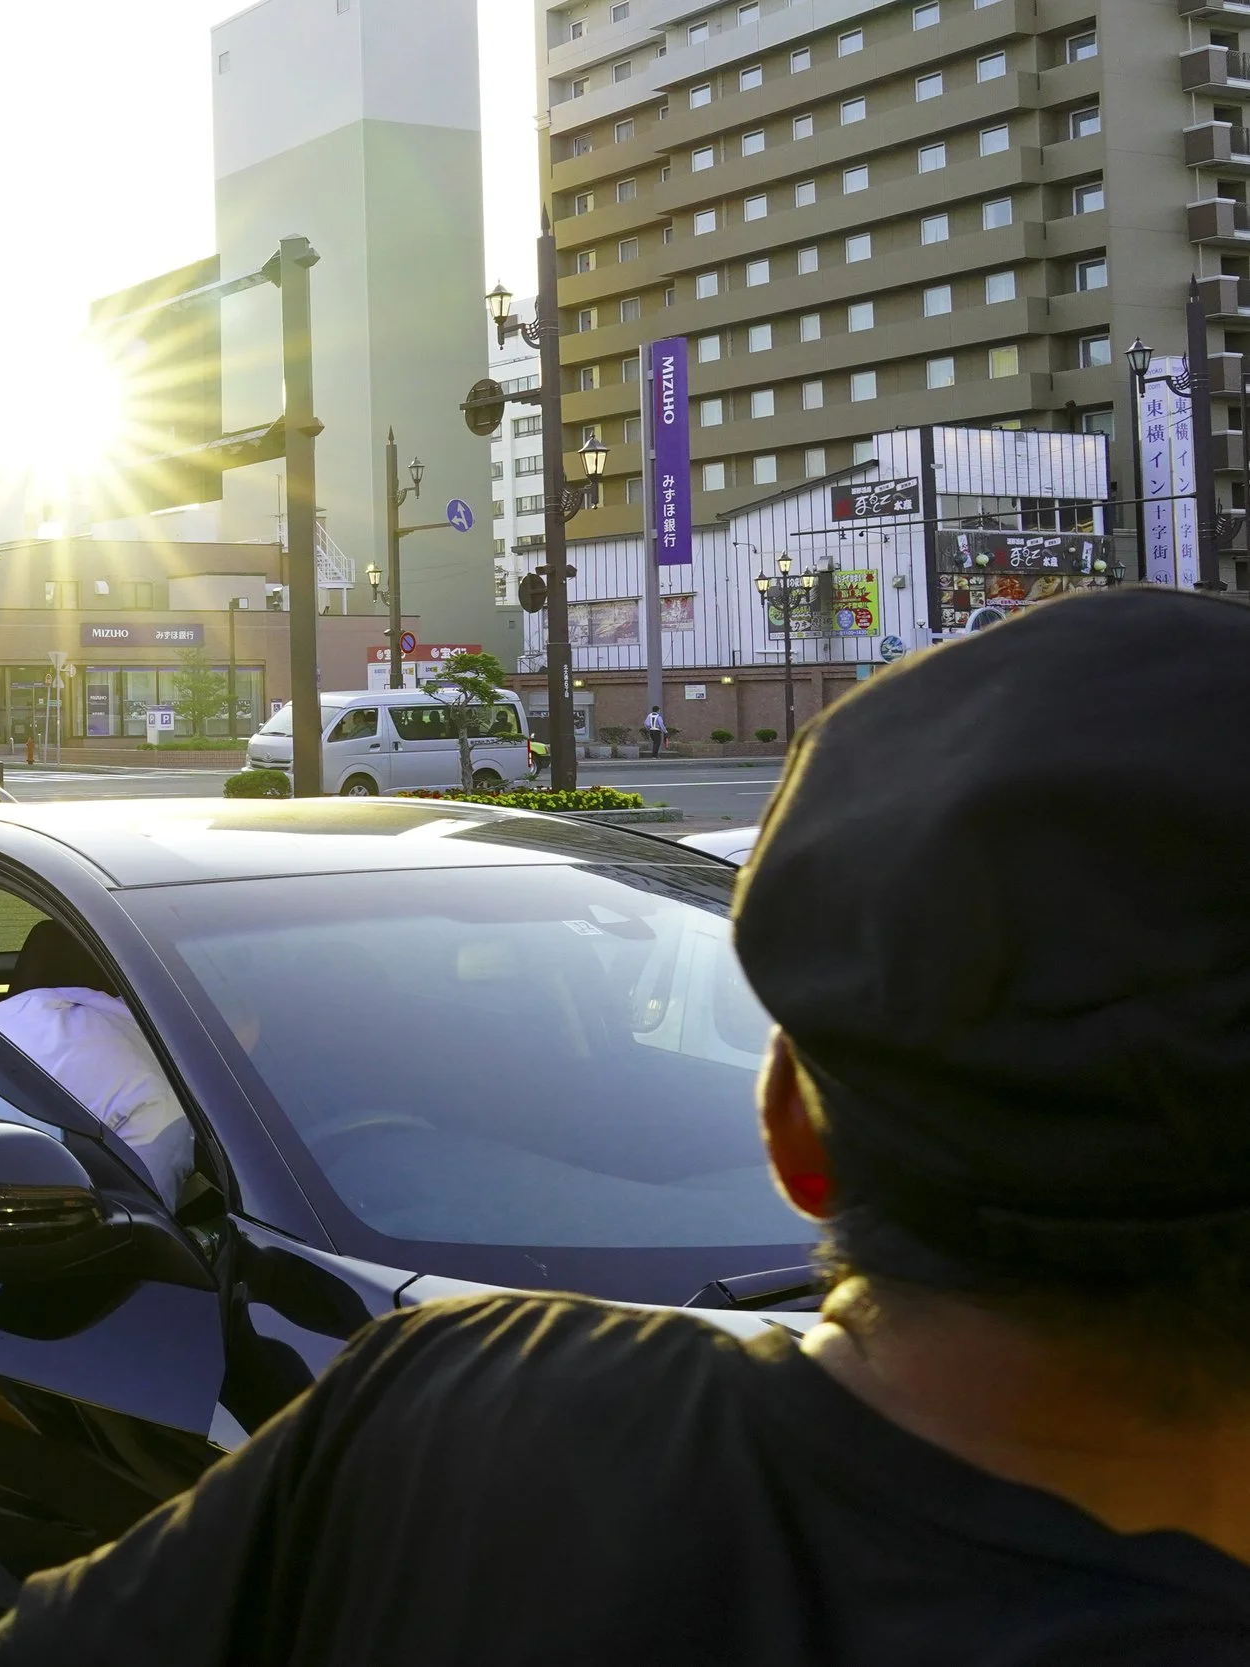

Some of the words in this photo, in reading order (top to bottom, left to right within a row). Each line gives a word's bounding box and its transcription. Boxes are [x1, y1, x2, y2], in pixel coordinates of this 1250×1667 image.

[661, 356, 675, 425] MIZUHO
[662, 474, 677, 548] みずほ銀行
[1146, 399, 1168, 560] 東横イン十字街
[92, 628, 129, 638] MIZUHO
[155, 630, 194, 640] みずほ銀行
